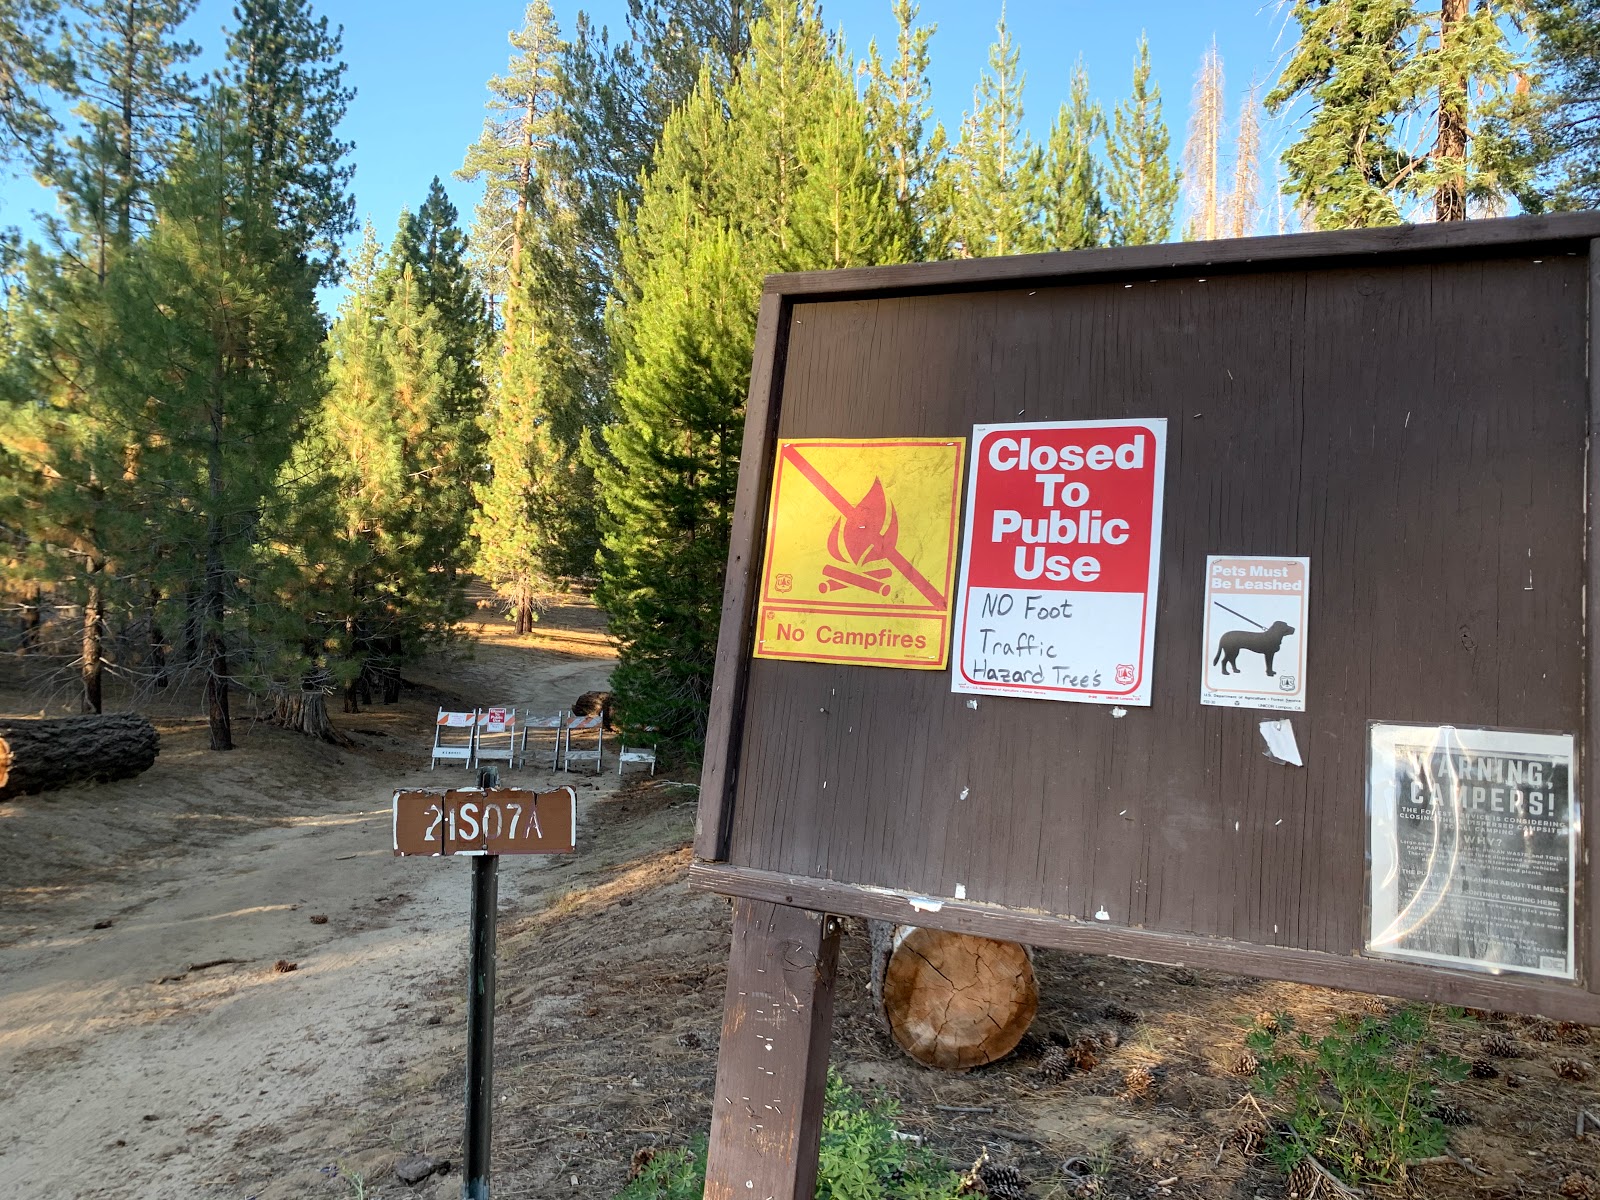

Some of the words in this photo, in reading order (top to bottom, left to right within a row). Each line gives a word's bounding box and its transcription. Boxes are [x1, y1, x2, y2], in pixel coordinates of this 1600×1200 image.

[988, 434, 1145, 472] Closed
[1035, 473, 1090, 508] To
[991, 509, 1130, 546] Public
[1013, 545, 1101, 583] Use
[1212, 565, 1246, 576] Pets
[1249, 565, 1288, 578] Must
[1211, 577, 1231, 589] Be
[1235, 578, 1302, 591] Leashed
[981, 592, 1014, 619] NO
[1024, 595, 1073, 620] Foot
[776, 623, 805, 642] No
[816, 625, 927, 650] Campfires
[979, 628, 1058, 659] Traffic
[972, 659, 1045, 685] Hazard
[1052, 665, 1102, 688] Tree's
[1411, 781, 1555, 816] CAMPERS!
[424, 803, 543, 841] 21S07A
[1399, 813, 1435, 821] CLOSING
[1438, 816, 1464, 825] THEE
[1467, 818, 1514, 829] DISPERSED
[1455, 812, 1490, 820] ERVICE
[1503, 816, 1566, 828] CONSIDERING
[1474, 827, 1517, 836] CAMPING.
[1463, 835, 1502, 847] WHY?
[1465, 889, 1500, 899] CONTINUE
[1501, 894, 1536, 904] CAMPING
[1500, 880, 1526, 888] ABOUT
[1526, 883, 1542, 891] THE
[1542, 885, 1567, 893] MESS.
